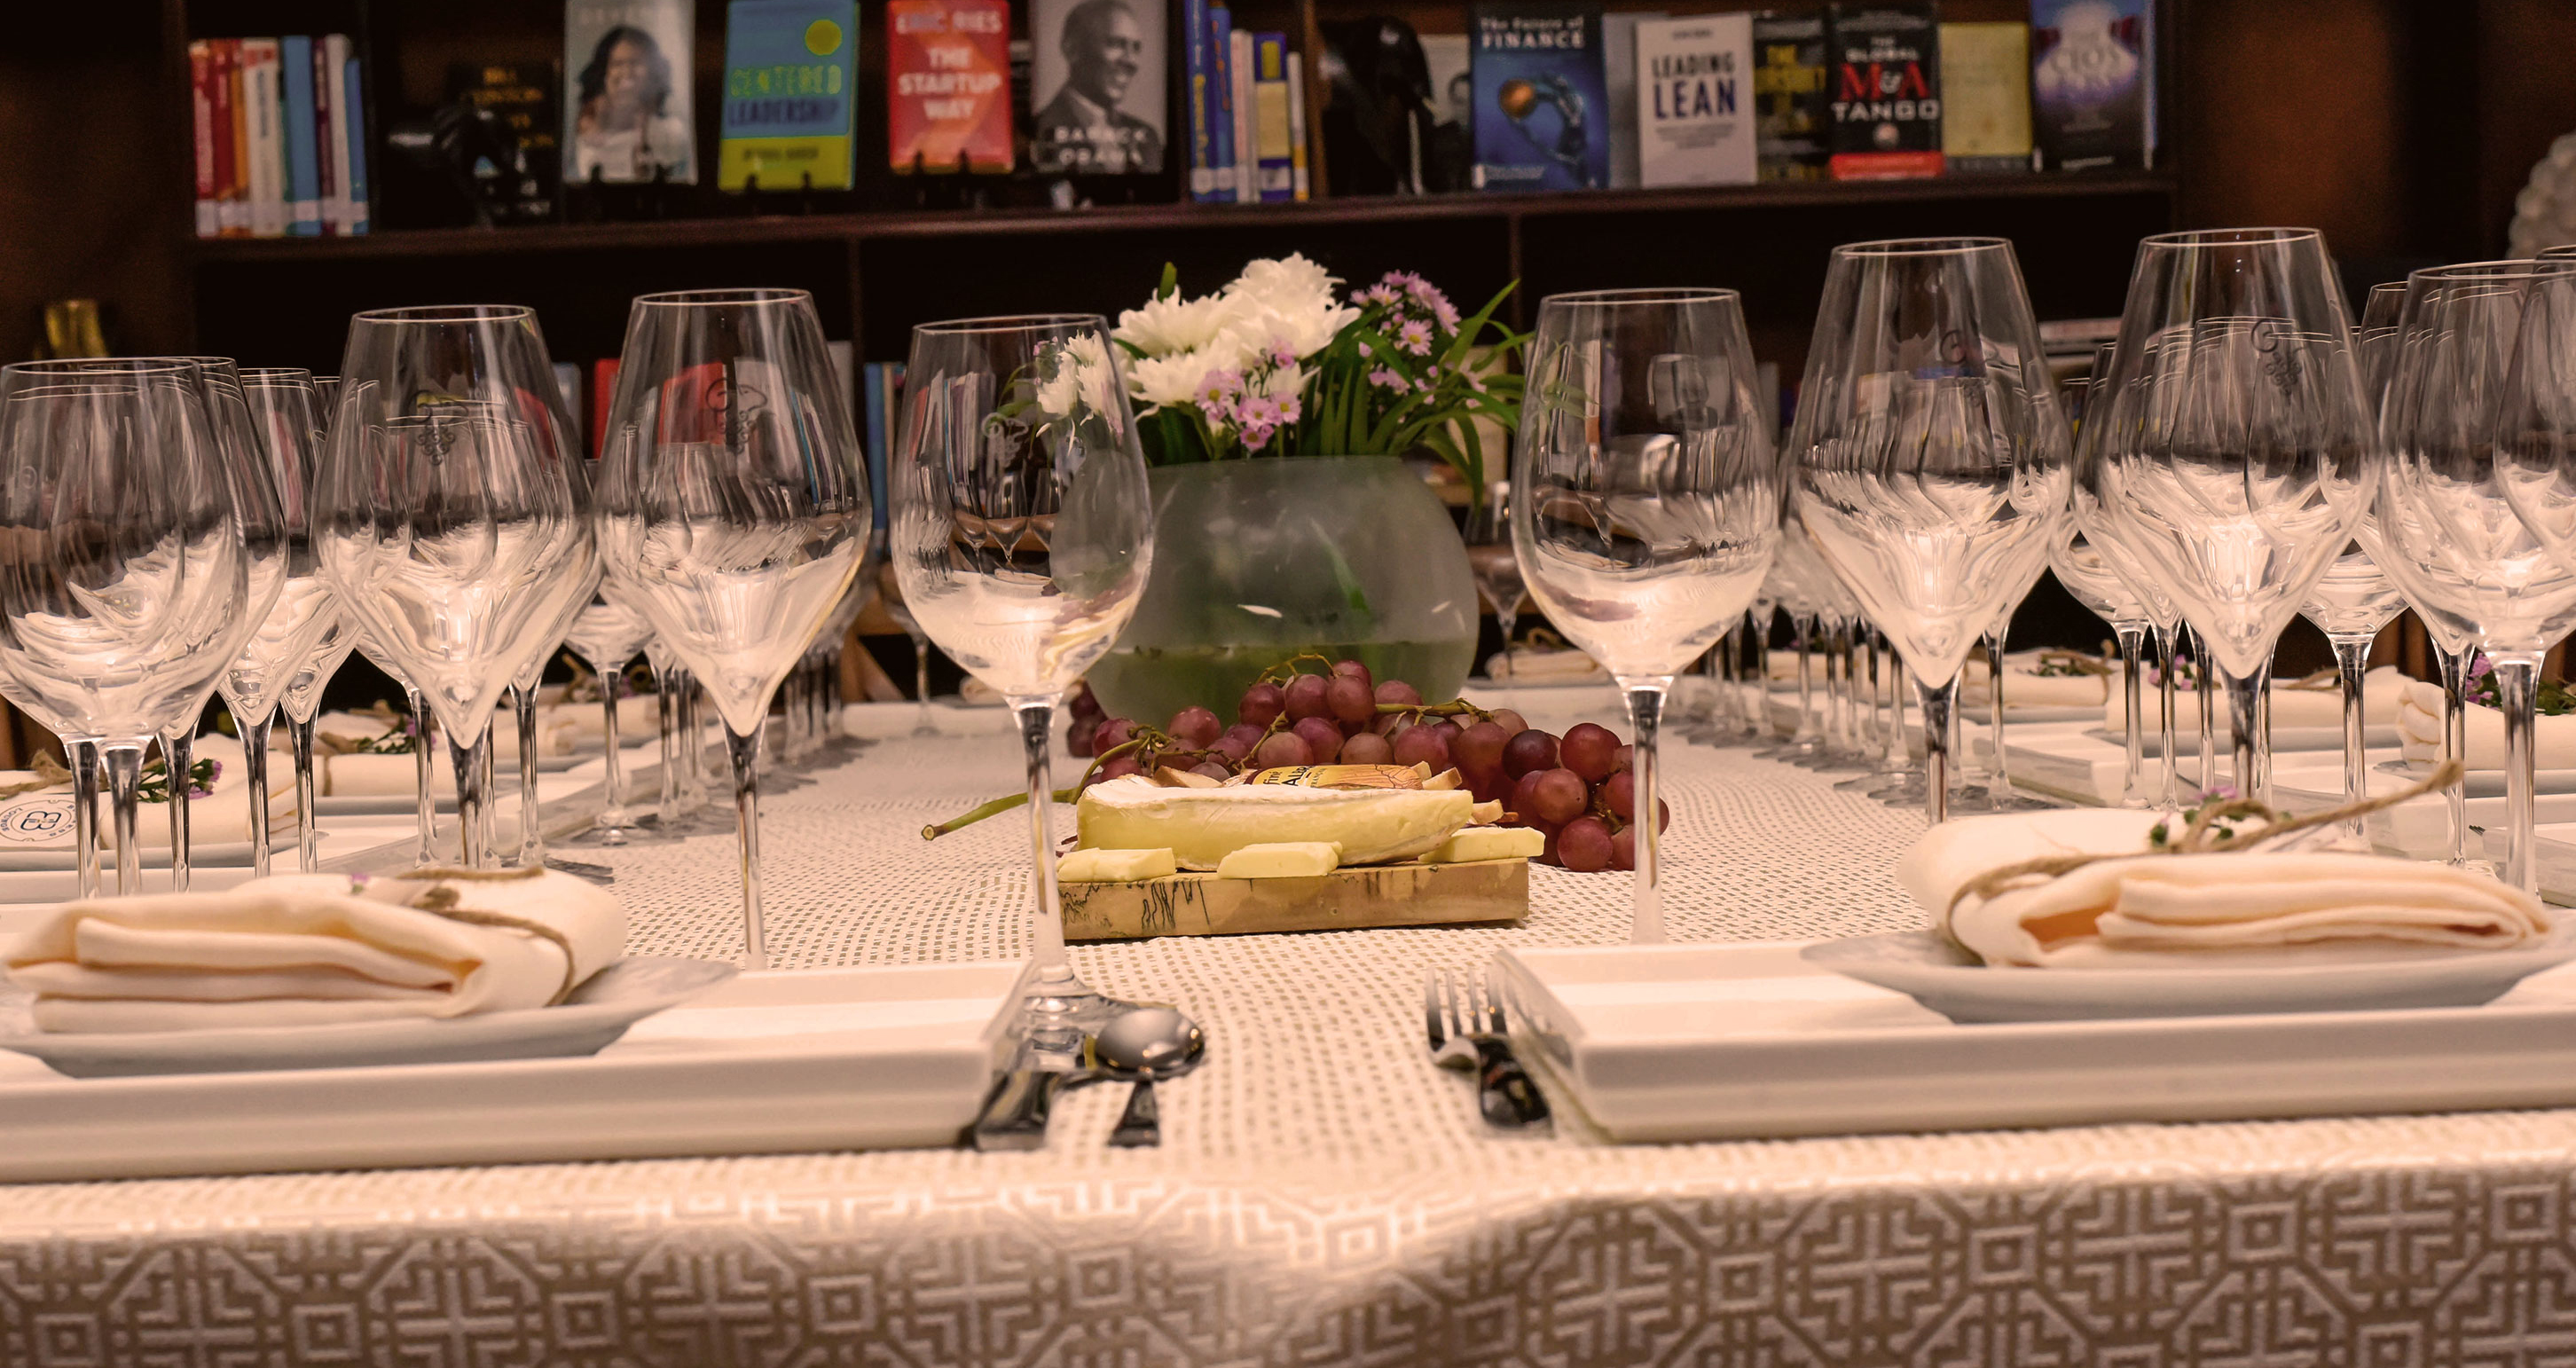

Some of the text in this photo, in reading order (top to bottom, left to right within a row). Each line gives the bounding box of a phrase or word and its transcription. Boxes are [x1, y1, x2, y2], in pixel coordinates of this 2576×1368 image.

[1481, 30, 1584, 50] FINANCE
[929, 46, 973, 68] THE
[1651, 52, 1735, 78] LEADING
[730, 64, 842, 98] CENTERED
[897, 73, 1002, 96] STARTUP
[1839, 62, 1930, 101] M&A
[923, 98, 974, 121] WAY
[1653, 78, 1736, 120] LEAN
[1831, 99, 1940, 122] TANGO
[727, 98, 839, 127] LEADERSHIP
[1054, 126, 1147, 144] BARACK
[1058, 146, 1143, 166] OBAMA
